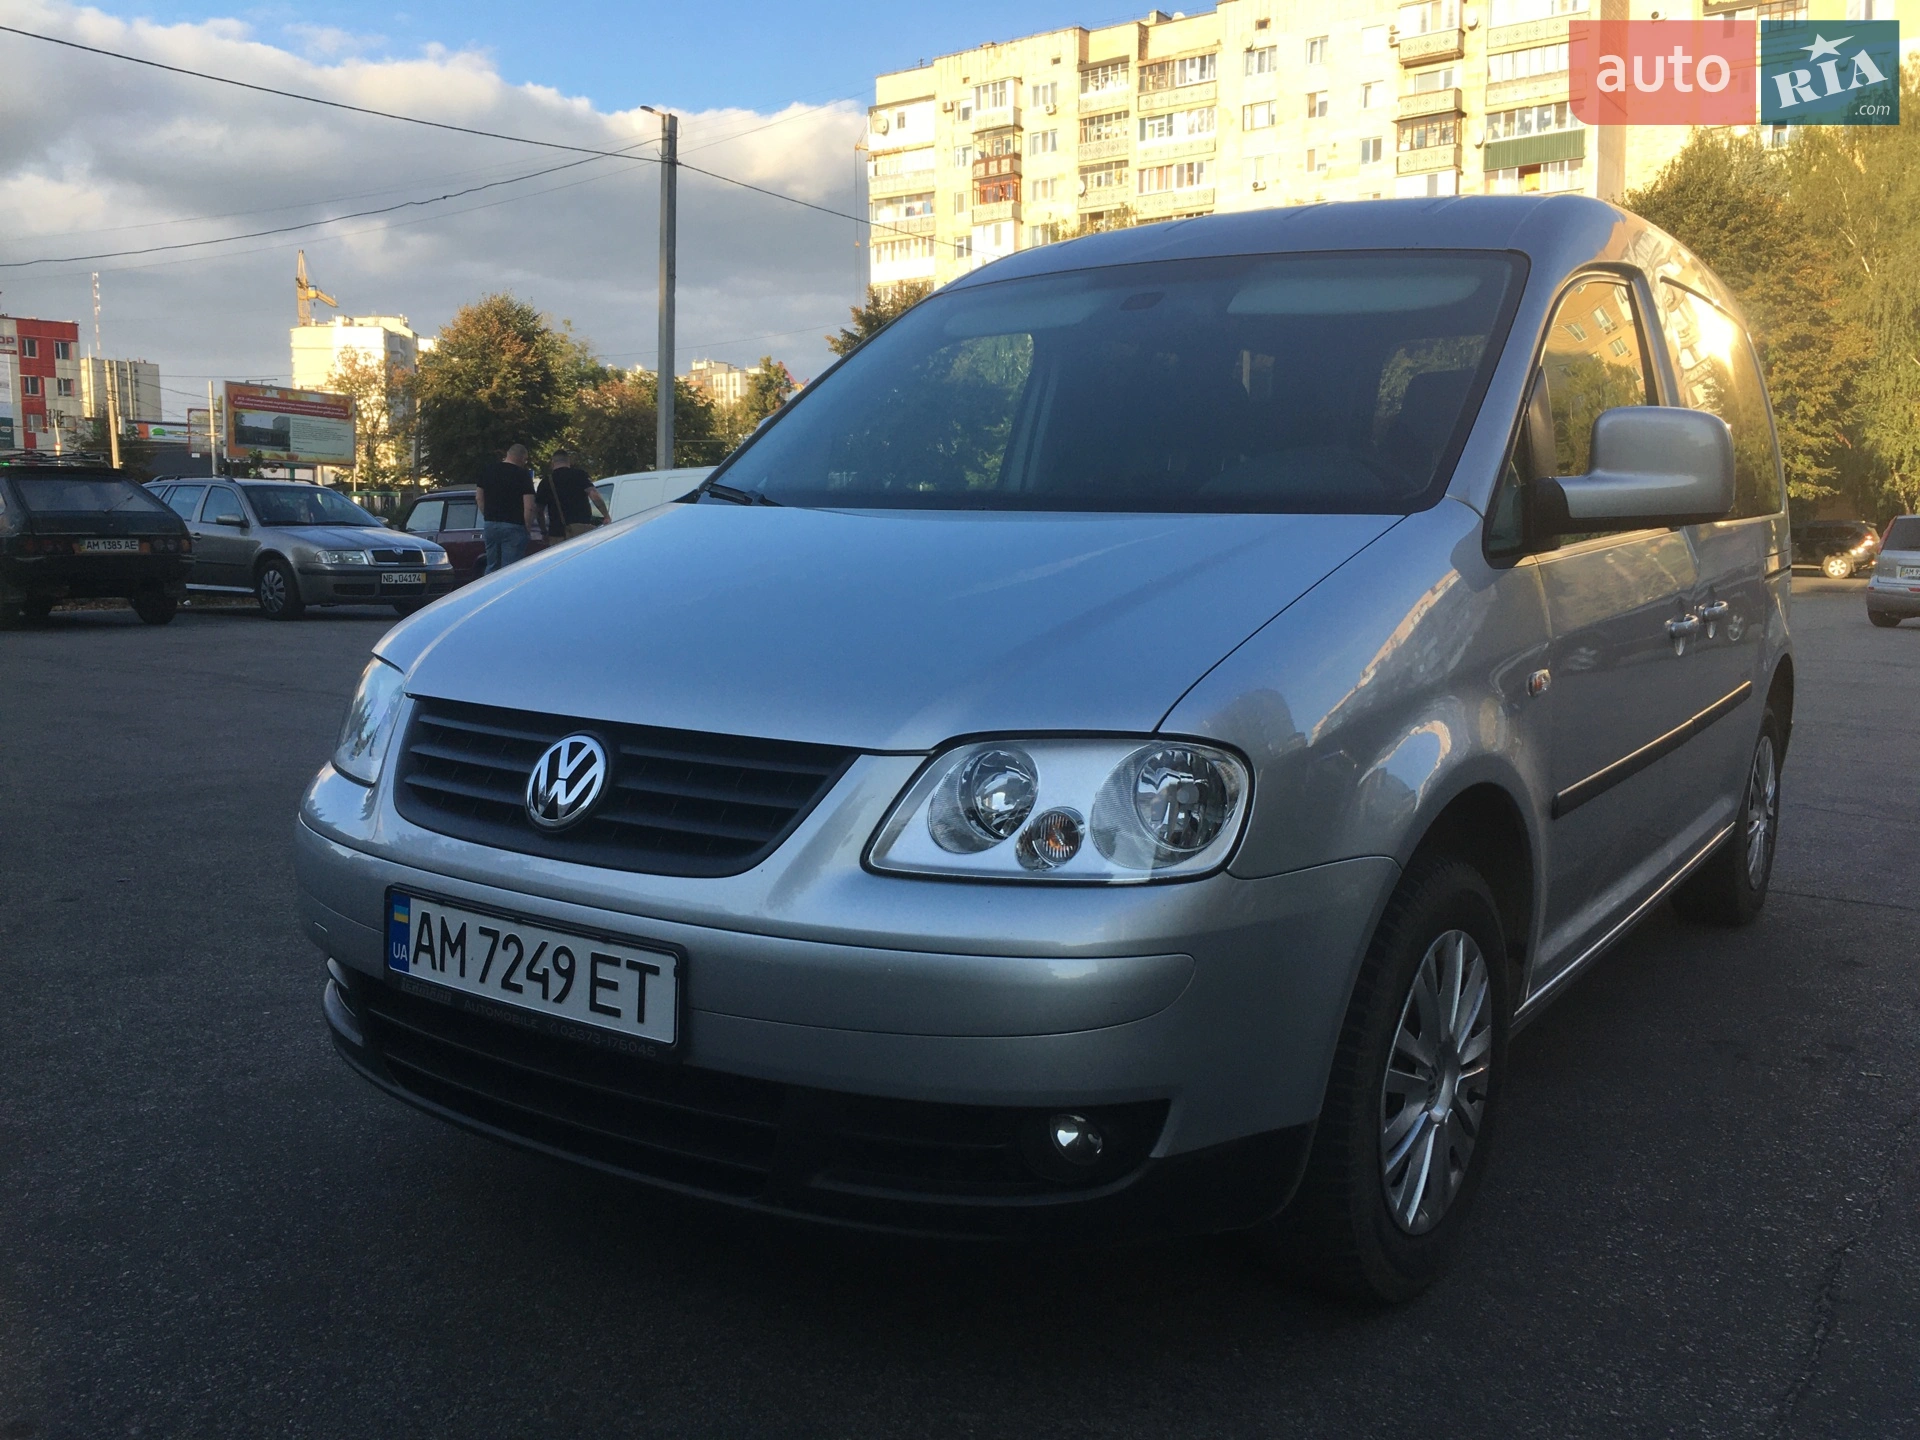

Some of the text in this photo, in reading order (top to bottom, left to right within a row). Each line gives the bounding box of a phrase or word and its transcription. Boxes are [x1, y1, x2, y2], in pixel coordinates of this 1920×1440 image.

[86, 540, 137, 550] AM 1385 AE
[393, 944, 408, 962] UA
[412, 911, 660, 1024] AM 7249 ET
